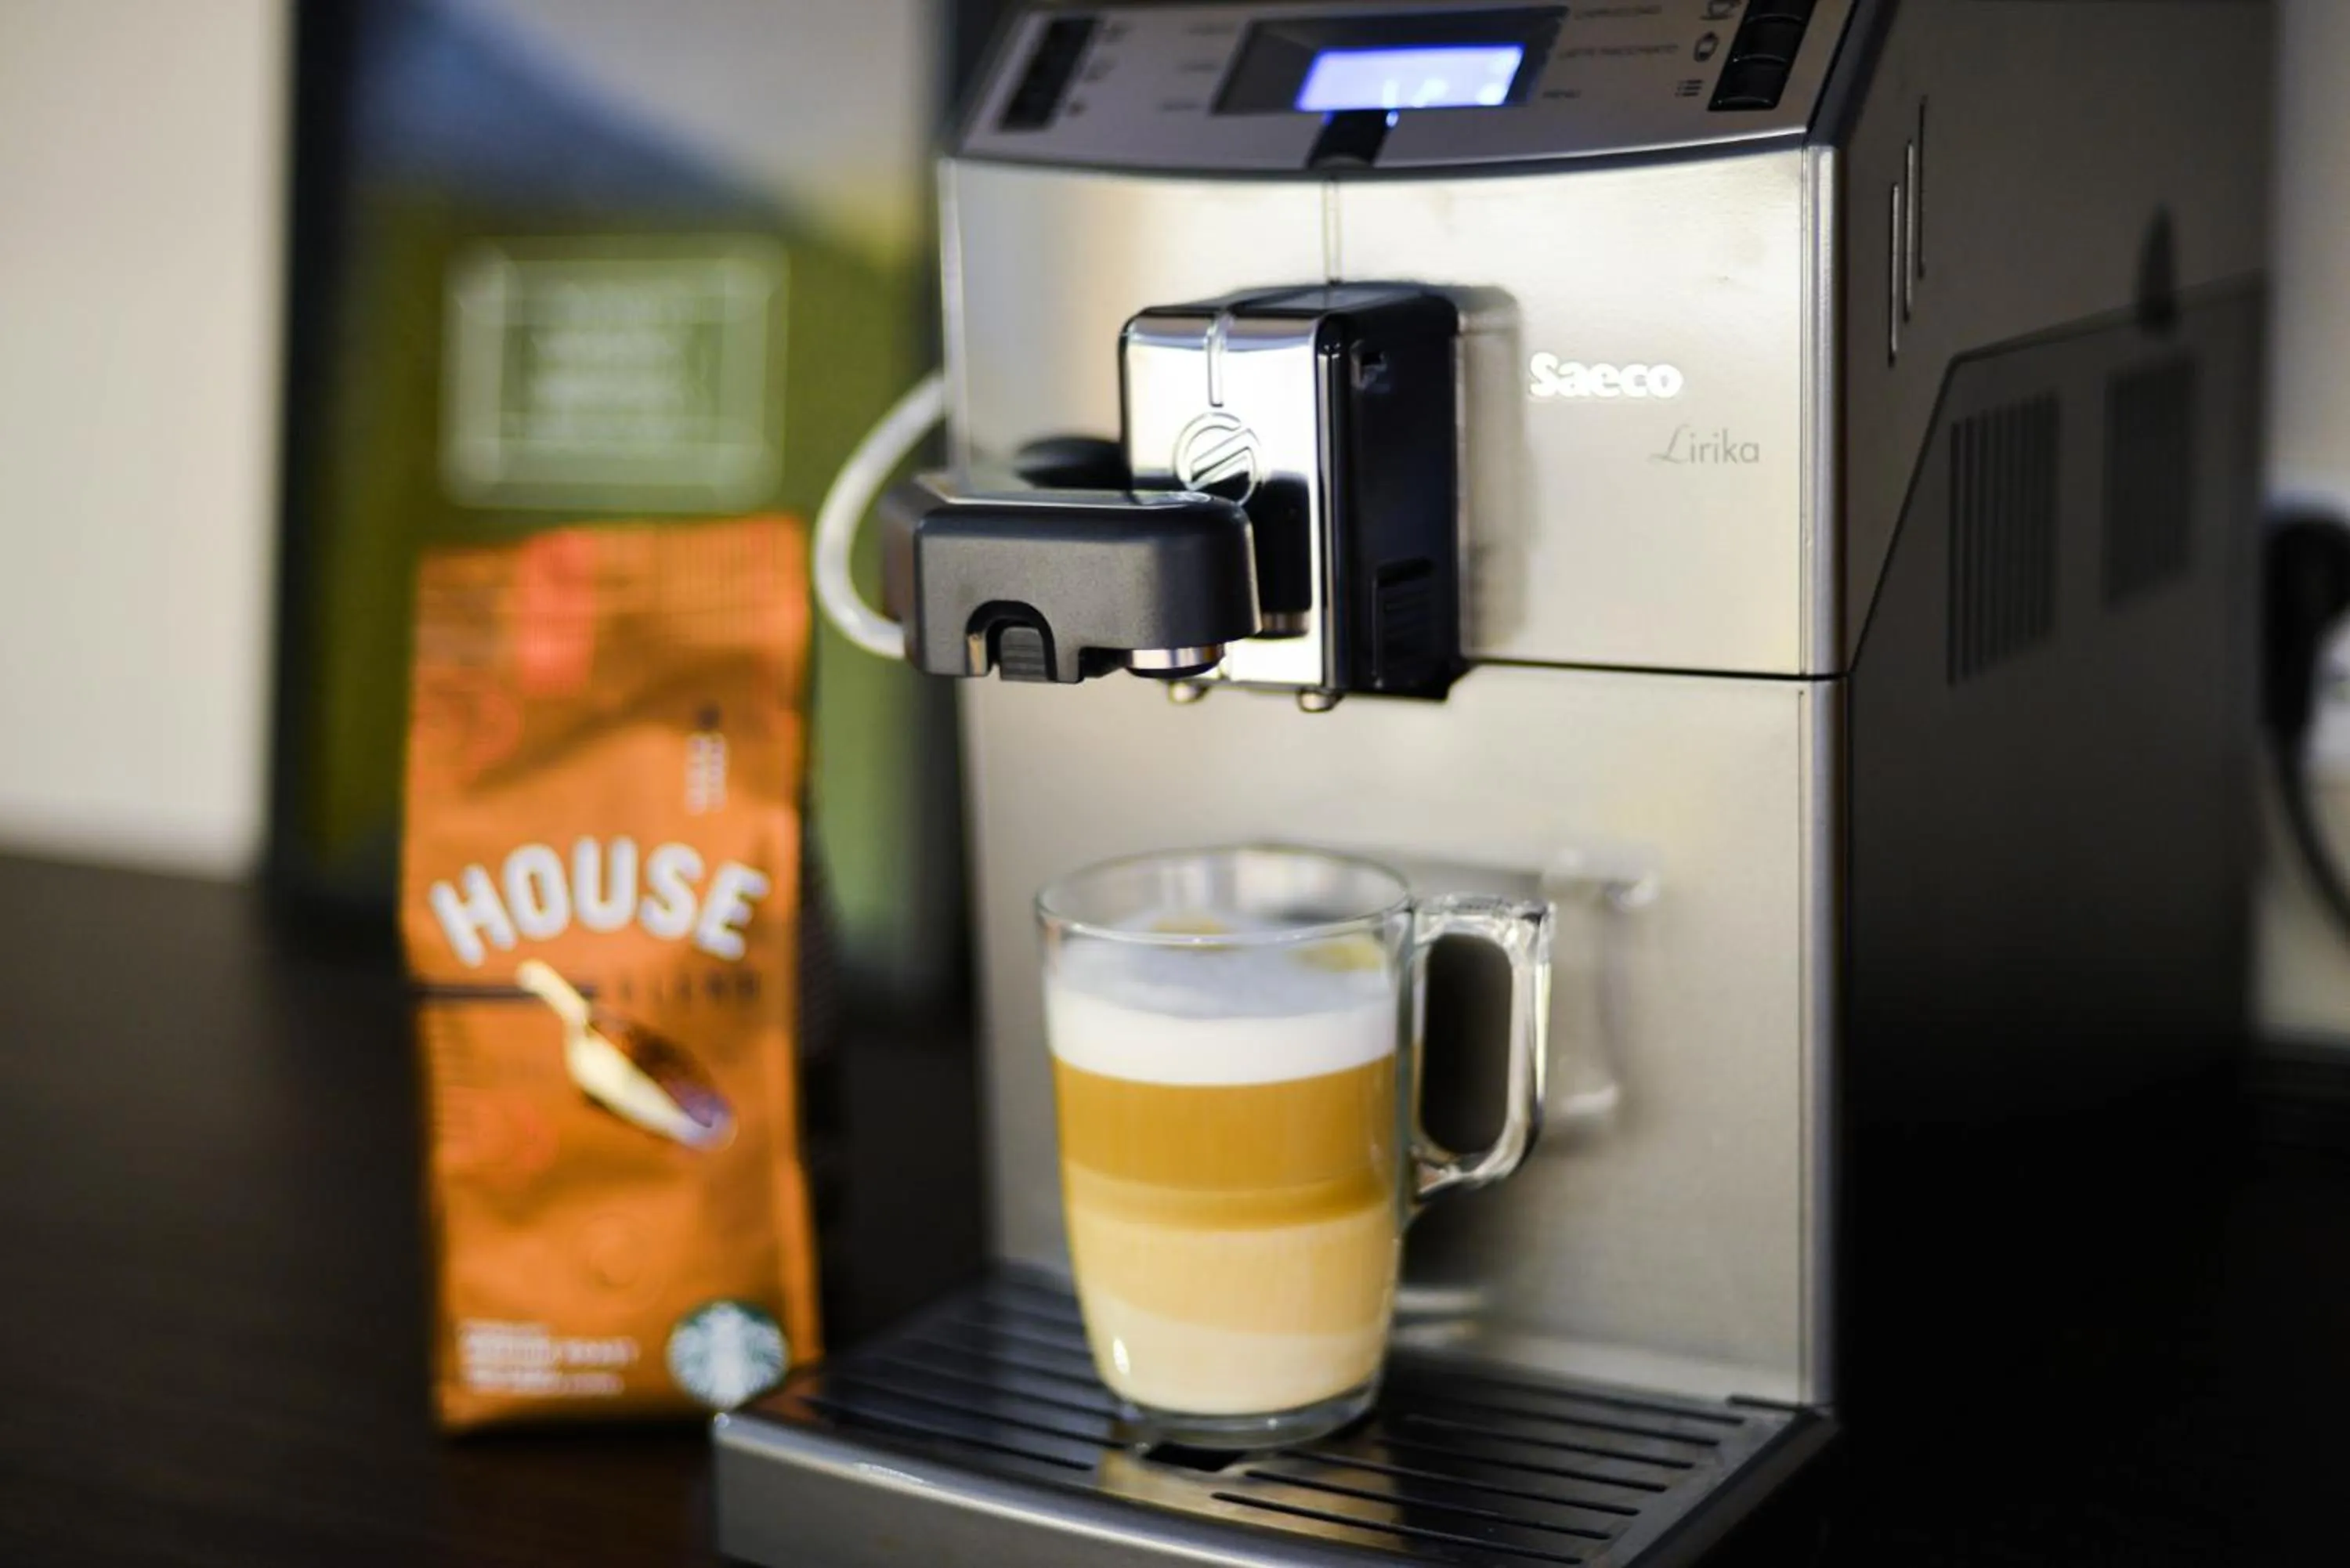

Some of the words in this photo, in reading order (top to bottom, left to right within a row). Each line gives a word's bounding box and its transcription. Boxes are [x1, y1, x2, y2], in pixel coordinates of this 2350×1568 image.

[1529, 352, 1683, 398] Saeco
[1649, 424, 1760, 464] Lirika
[430, 836, 771, 967] HOUSE
